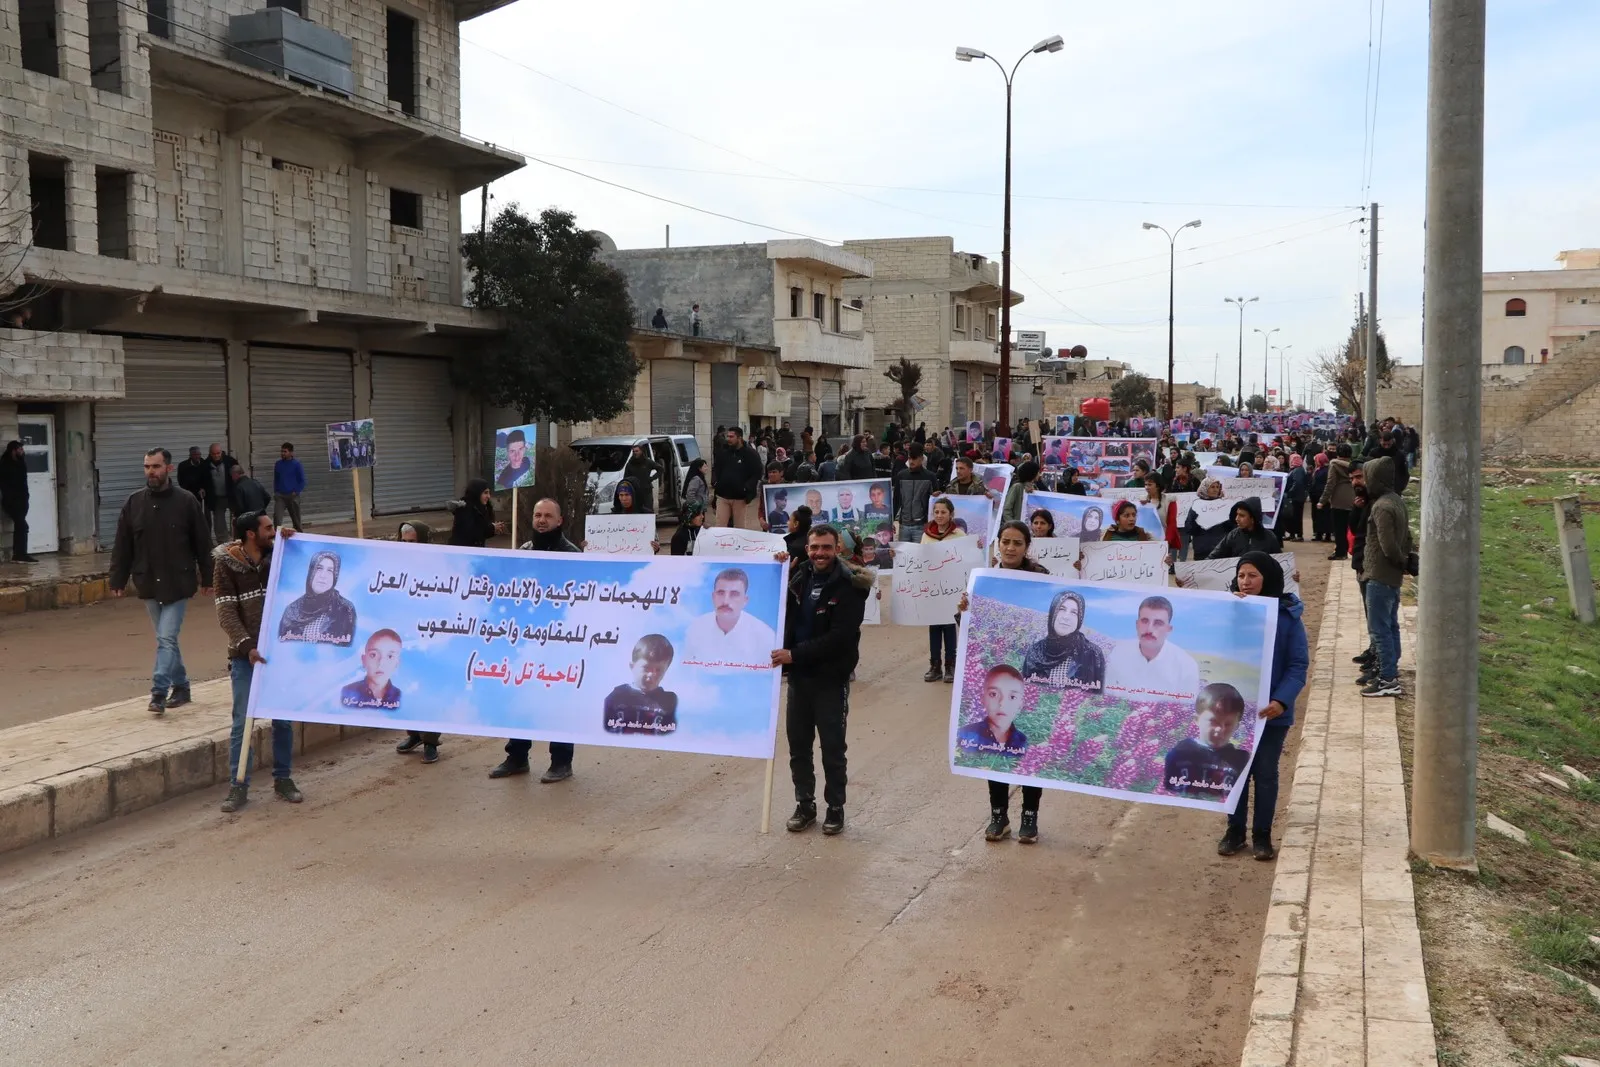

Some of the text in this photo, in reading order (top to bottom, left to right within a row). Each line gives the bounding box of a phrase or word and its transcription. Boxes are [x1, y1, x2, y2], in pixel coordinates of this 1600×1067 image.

[1107, 546, 1143, 561] أردوغان
[369, 570, 407, 594] العزل
[1090, 563, 1155, 581] قاتل الأطفال
[409, 576, 459, 597] المدنيين
[461, 576, 494, 602] وقتل
[599, 582, 667, 610] للهجمات
[670, 585, 681, 605] لا
[930, 572, 968, 597] أردوغان
[417, 611, 475, 638] الشعوب
[589, 626, 619, 650] نعم
[514, 661, 533, 686] تل
